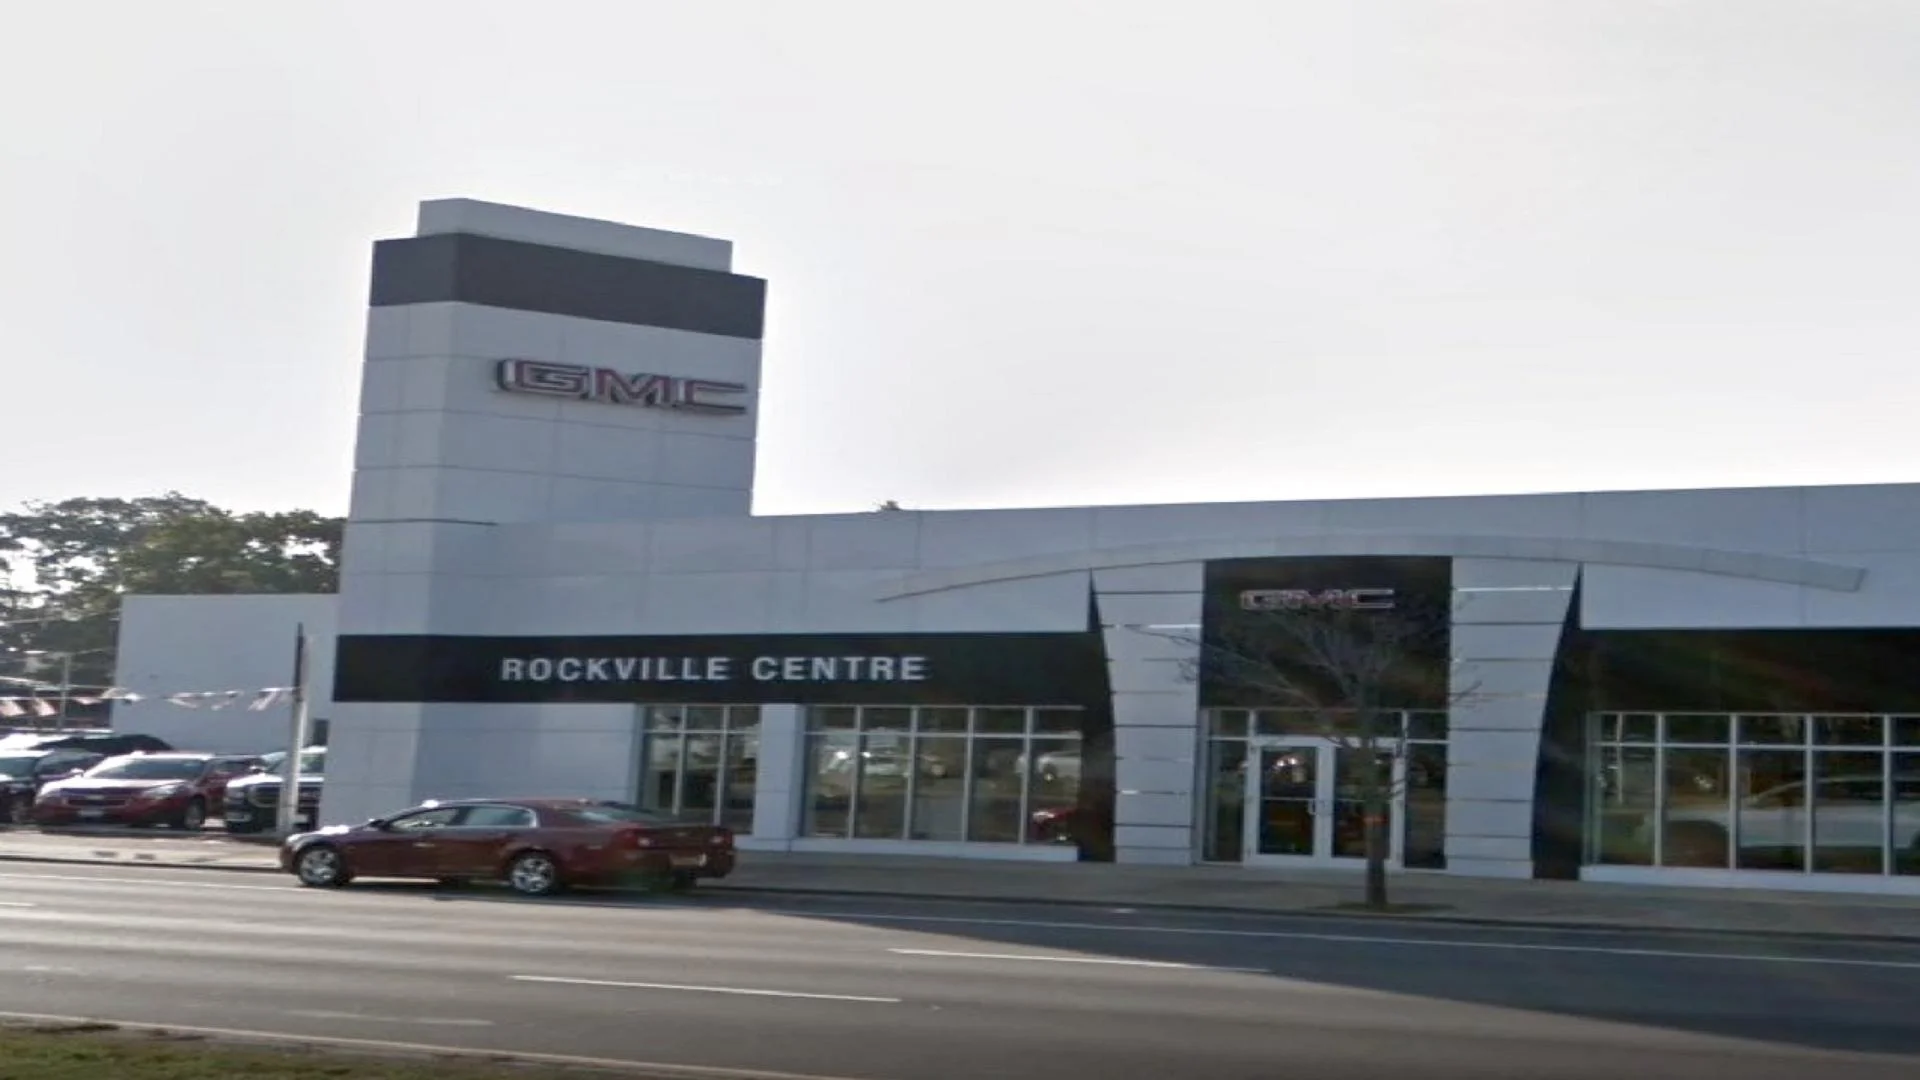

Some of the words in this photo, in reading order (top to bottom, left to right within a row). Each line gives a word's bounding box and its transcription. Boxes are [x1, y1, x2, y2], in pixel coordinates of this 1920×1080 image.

[496, 357, 747, 416] GMC
[1240, 588, 1396, 610] GMC
[501, 656, 731, 681] ROCKVILLE
[751, 656, 928, 682] CENTRE
